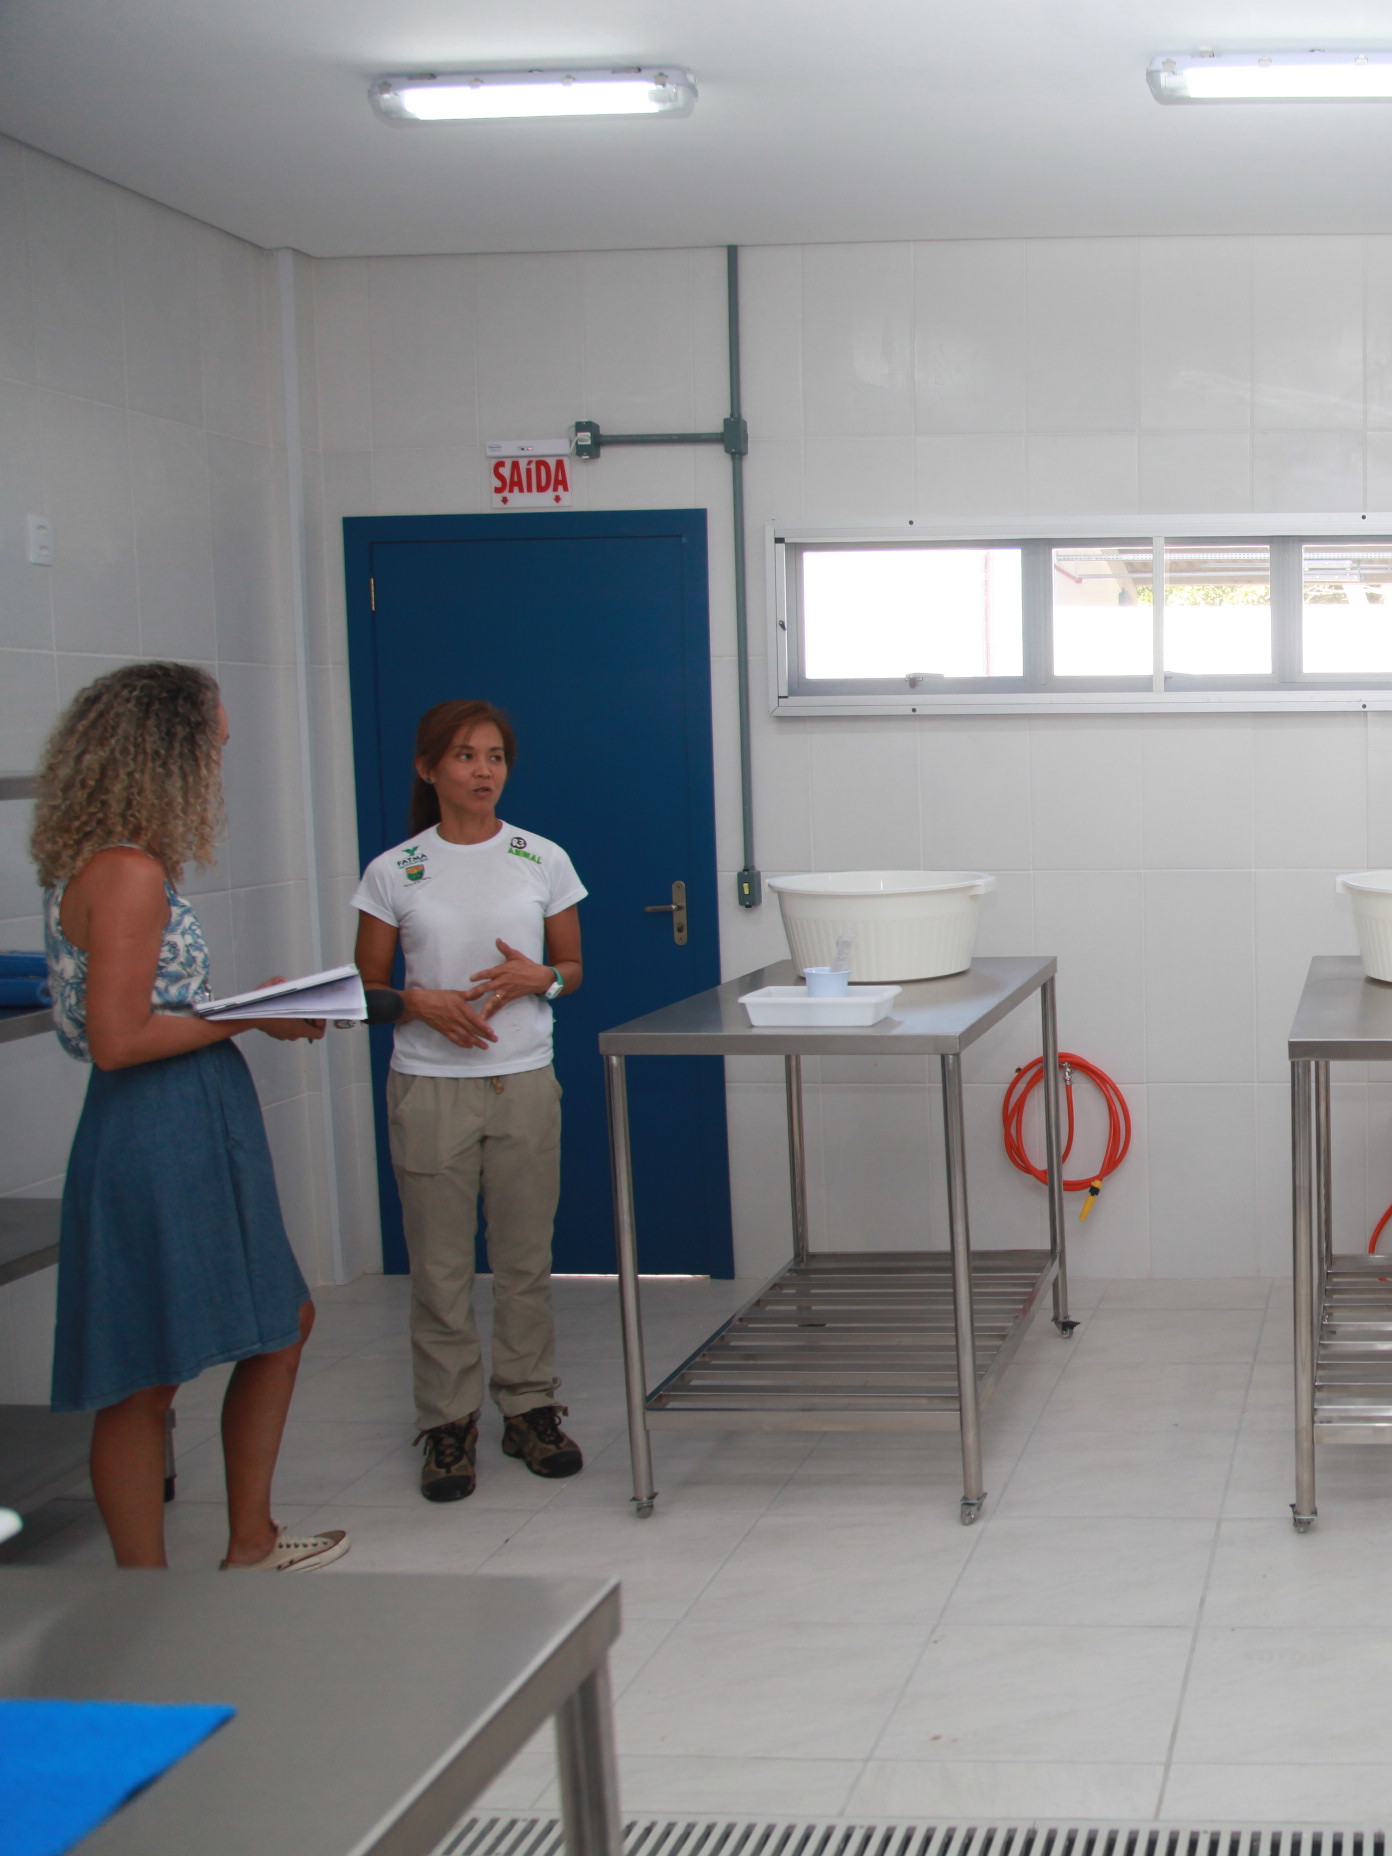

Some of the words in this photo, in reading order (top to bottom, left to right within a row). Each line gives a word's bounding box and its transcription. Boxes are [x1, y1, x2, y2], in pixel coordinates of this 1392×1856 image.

[493, 459, 569, 494] SAÍDA
[396, 853, 427, 867] FATMA
[507, 847, 542, 864] ANIMAL
